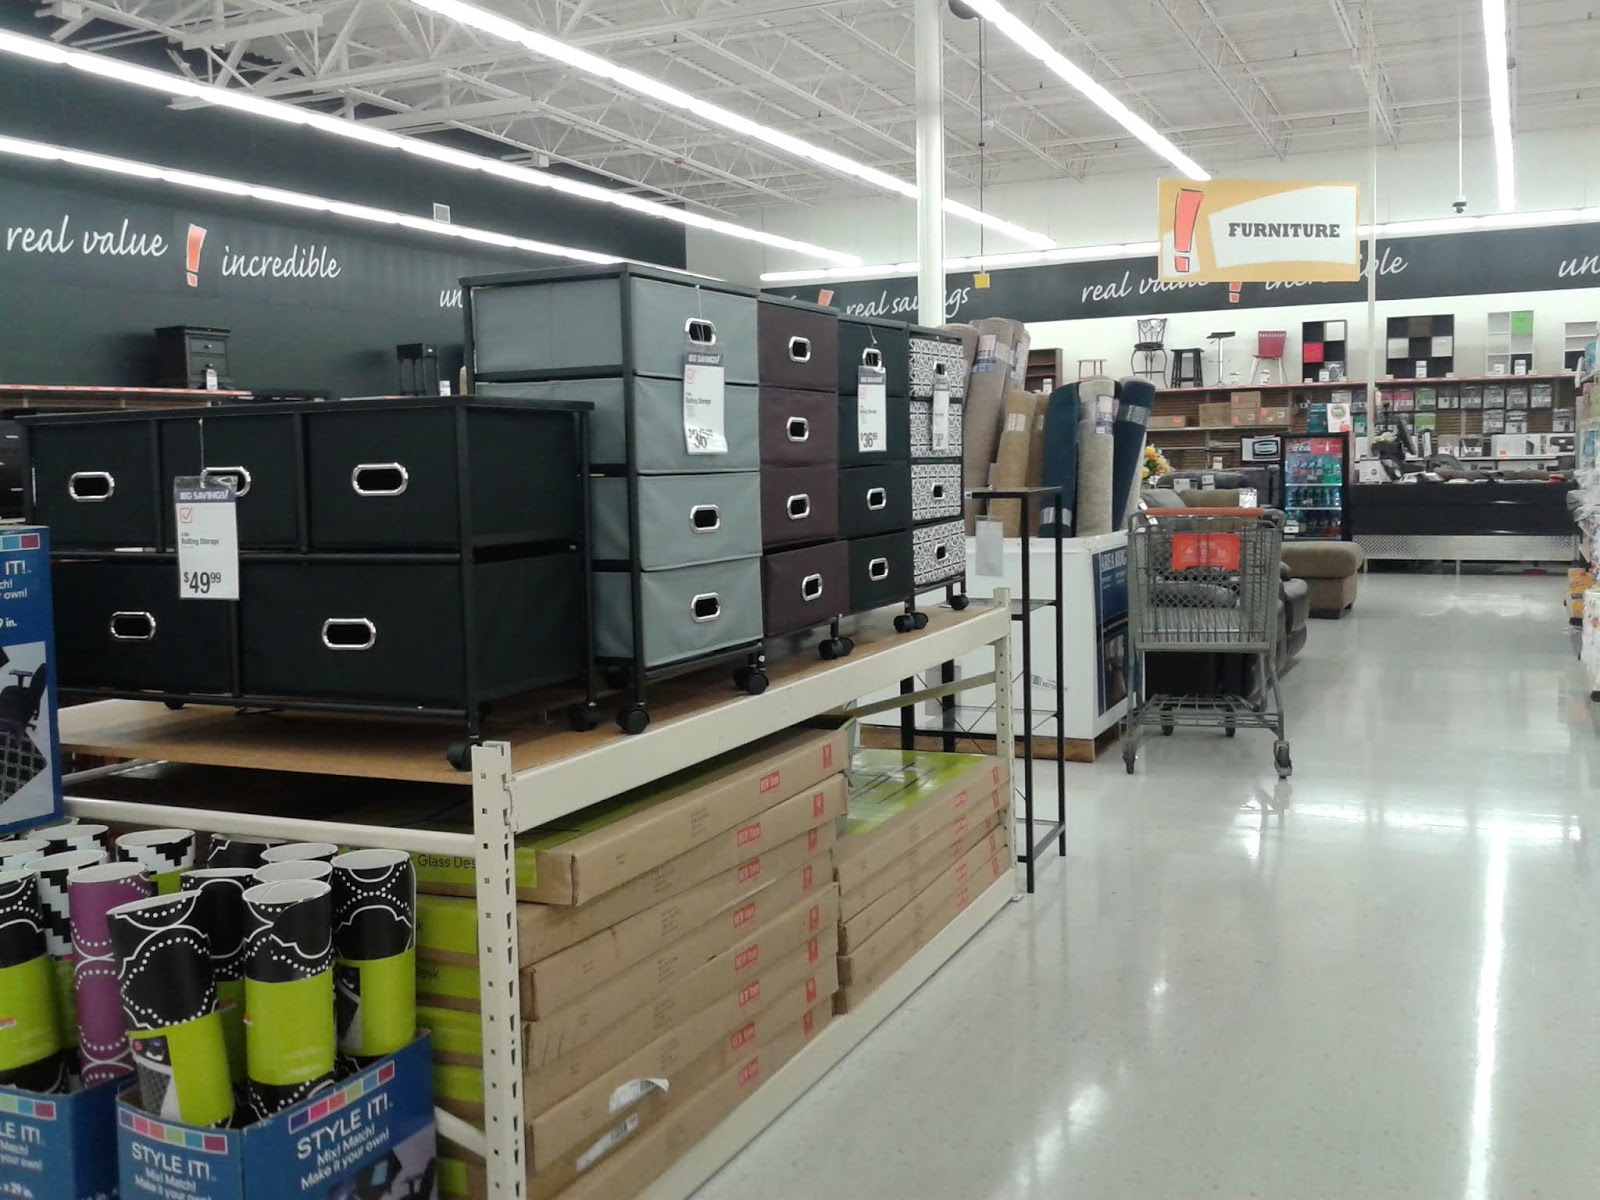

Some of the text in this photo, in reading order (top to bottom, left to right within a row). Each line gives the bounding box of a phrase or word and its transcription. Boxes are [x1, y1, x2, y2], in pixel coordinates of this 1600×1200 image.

[6, 214, 169, 257] real value
[1228, 222, 1341, 238] FURNITURE
[221, 243, 342, 279] incredible
[846, 286, 971, 319] real savgs
[1081, 271, 1132, 303] real
[5, 560, 26, 576] IT!
[3, 588, 28, 600] own!
[5, 617, 17, 628] in.
[417, 853, 451, 868] Glass
[453, 856, 476, 870] Des
[296, 1091, 389, 1160] STYLE IT!
[301, 1165, 333, 1191] Make
[341, 1145, 365, 1170] your
[365, 1125, 390, 1153] own!
[316, 1121, 377, 1168] Mix! Match!
[131, 1141, 211, 1181] STYLE IT!
